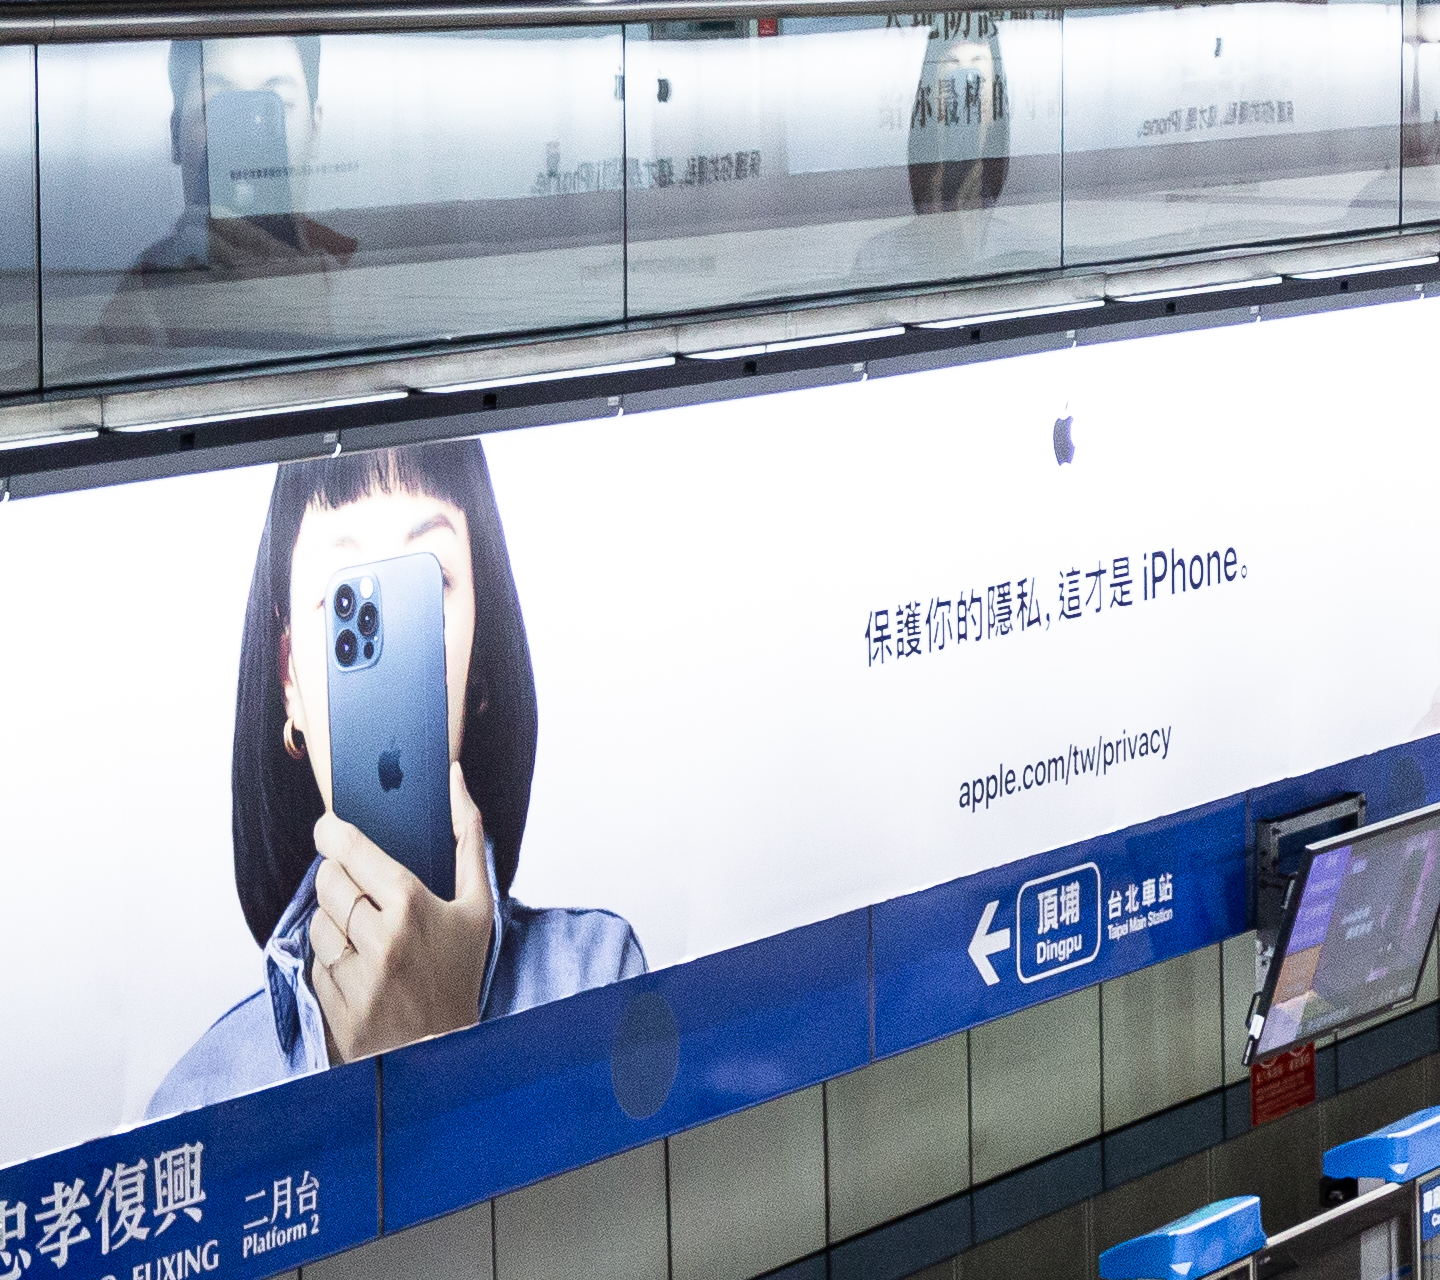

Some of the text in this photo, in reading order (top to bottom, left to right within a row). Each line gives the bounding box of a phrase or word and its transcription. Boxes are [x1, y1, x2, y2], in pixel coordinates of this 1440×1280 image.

[1143, 546, 1248, 600] iPhone。
[958, 726, 1172, 813] apple.com/tw/privacy
[1037, 880, 1080, 934] 頂埔
[1107, 873, 1173, 920] 台北車站
[1036, 934, 1082, 964] Dingpu
[1108, 908, 1173, 941] Taipei Main Station
[243, 1170, 320, 1230] 二月台
[243, 1213, 320, 1259] Platform 2
